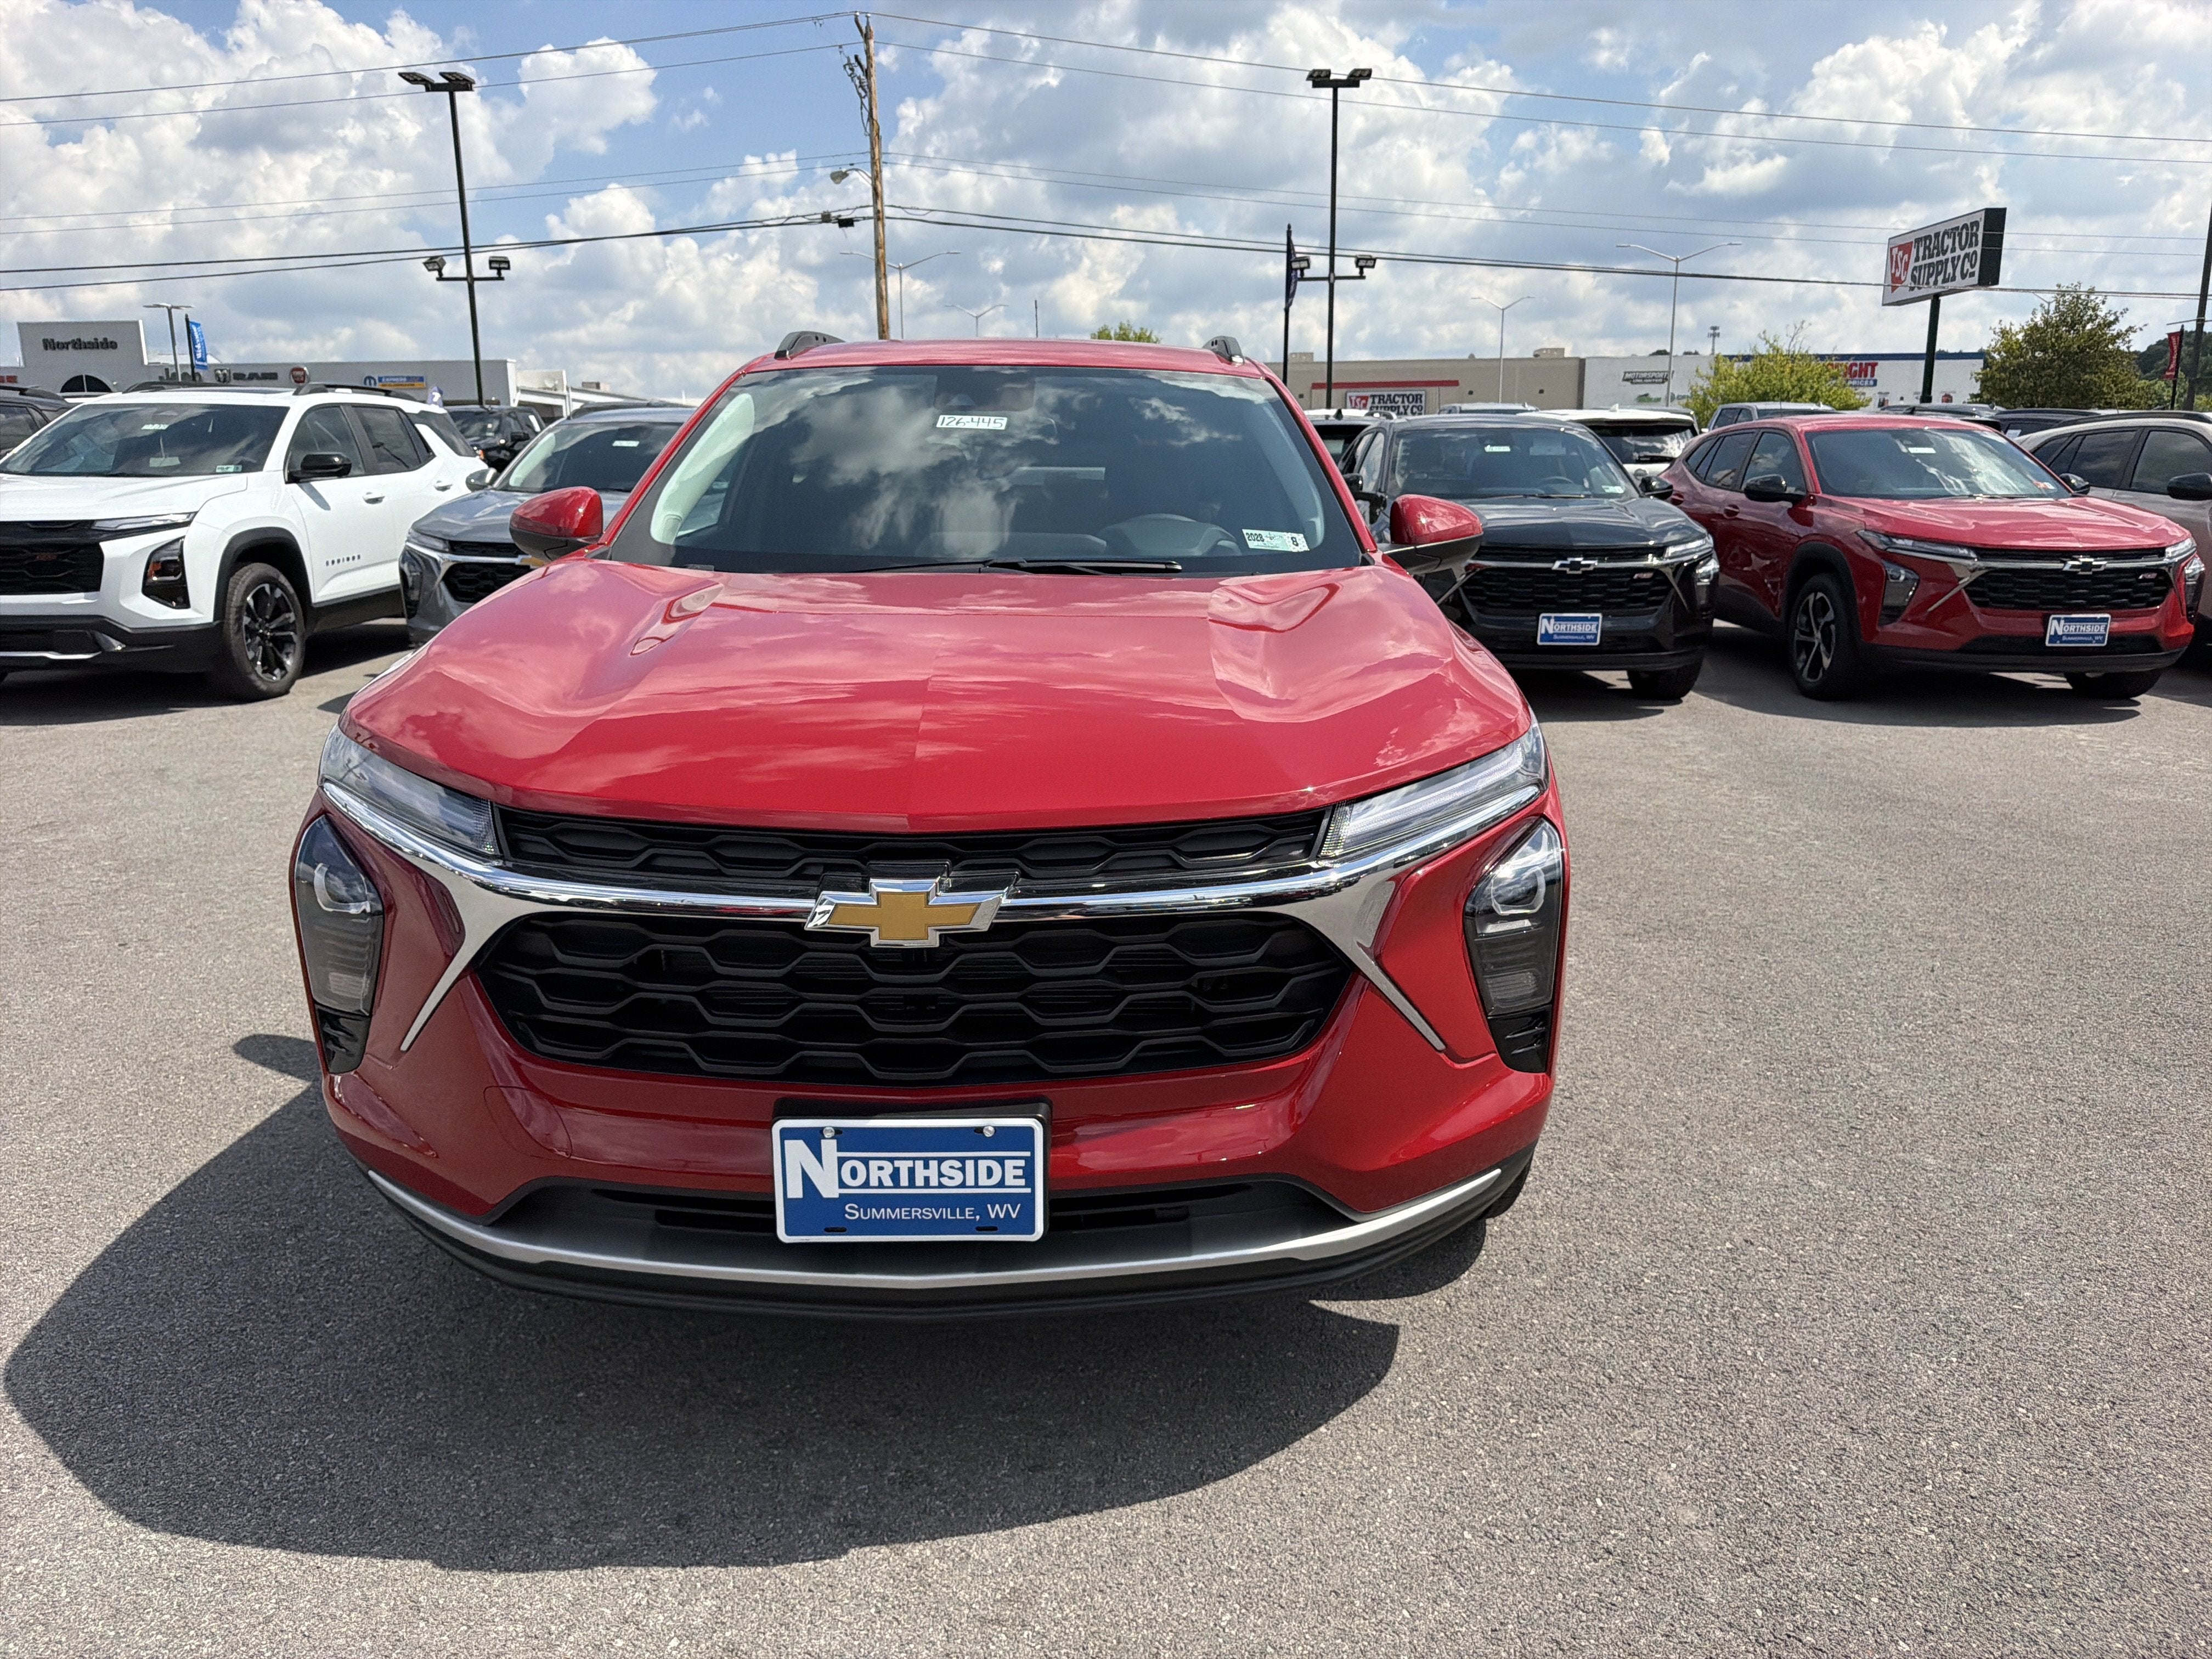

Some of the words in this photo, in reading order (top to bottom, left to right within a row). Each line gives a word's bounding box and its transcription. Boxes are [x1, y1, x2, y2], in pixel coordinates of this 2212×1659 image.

[1914, 220, 1980, 263] TRACTOR
[1891, 247, 1909, 281] TSC
[1909, 254, 1961, 291] SUPPLY
[42, 337, 118, 351] Northside
[1369, 393, 1423, 405] TRACTOR
[940, 416, 1005, 428] 126-445
[1246, 532, 1265, 542] 2028
[1541, 618, 1597, 634] NORTHSIDE
[2050, 619, 2106, 635] NORTHSIDE
[784, 1138, 1026, 1199] NORTHSIDE
[844, 1203, 980, 1221] SUMMERSVILLE,
[986, 1203, 1021, 1219] WV
